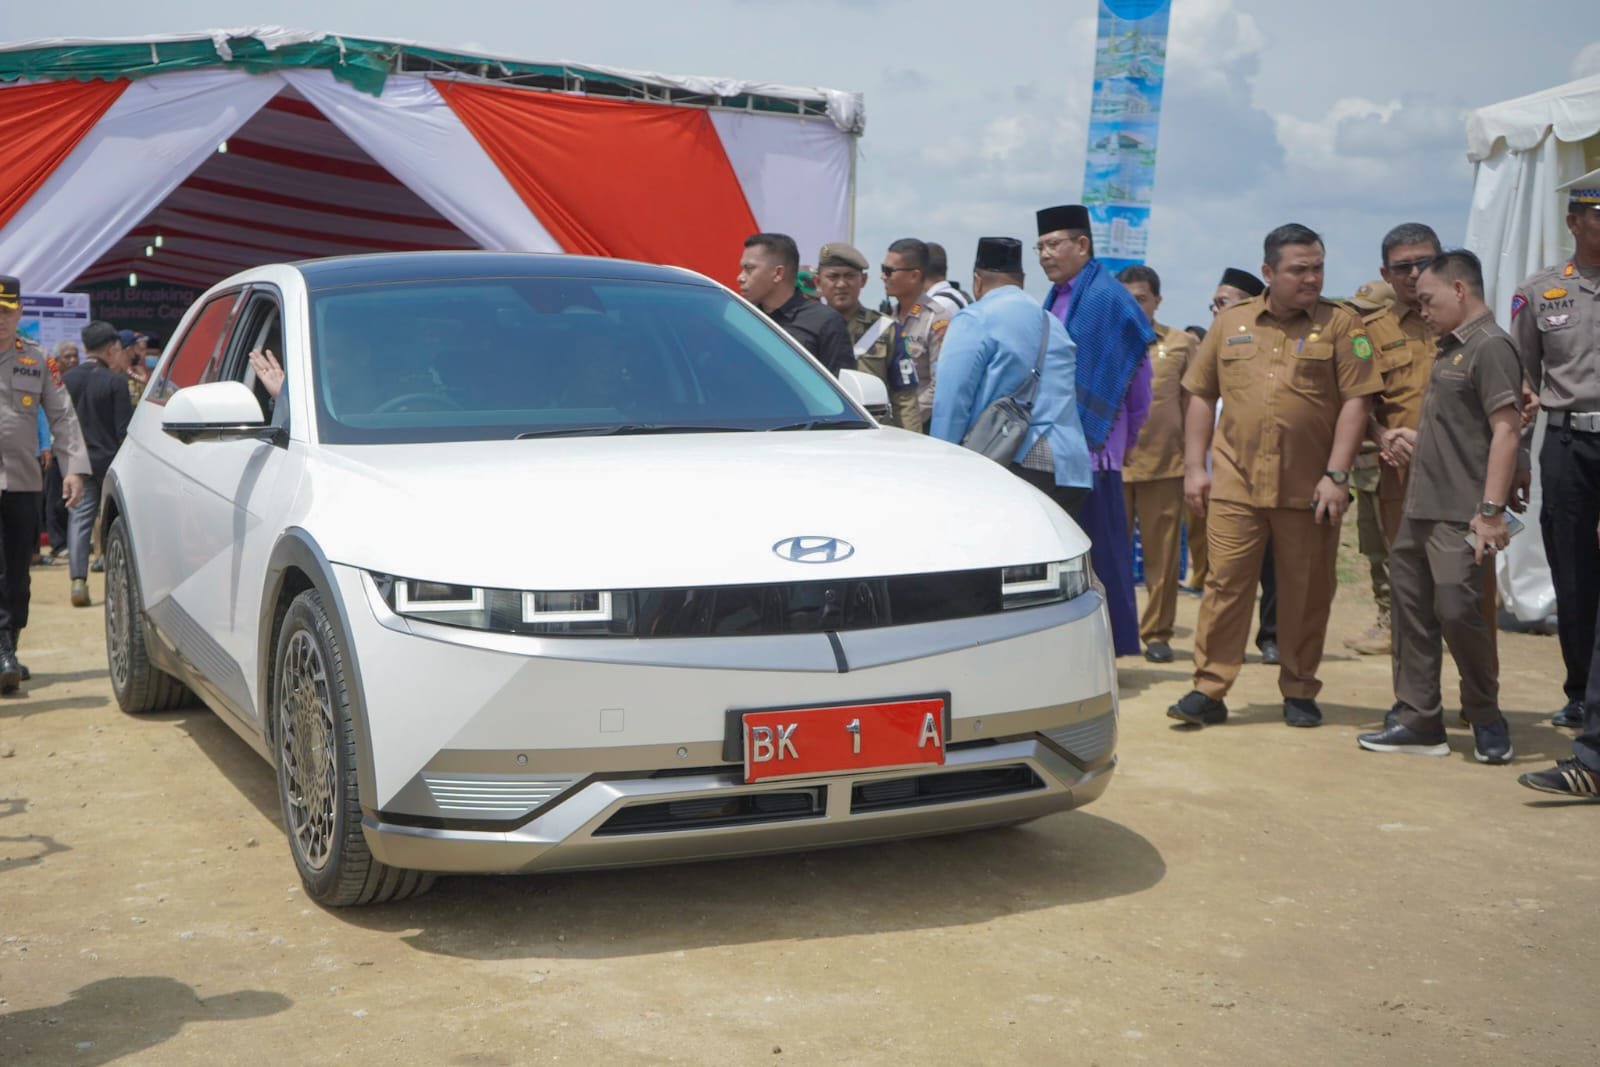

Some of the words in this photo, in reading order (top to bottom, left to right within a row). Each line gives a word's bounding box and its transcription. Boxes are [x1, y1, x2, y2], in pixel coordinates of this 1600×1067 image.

[124, 287, 194, 305] Breaking
[99, 303, 153, 319] Islamic
[1539, 299, 1574, 312] DAYAT
[13, 367, 41, 378] POLRI
[752, 723, 799, 762] BK
[845, 718, 861, 754] 1
[918, 712, 941, 748] A
